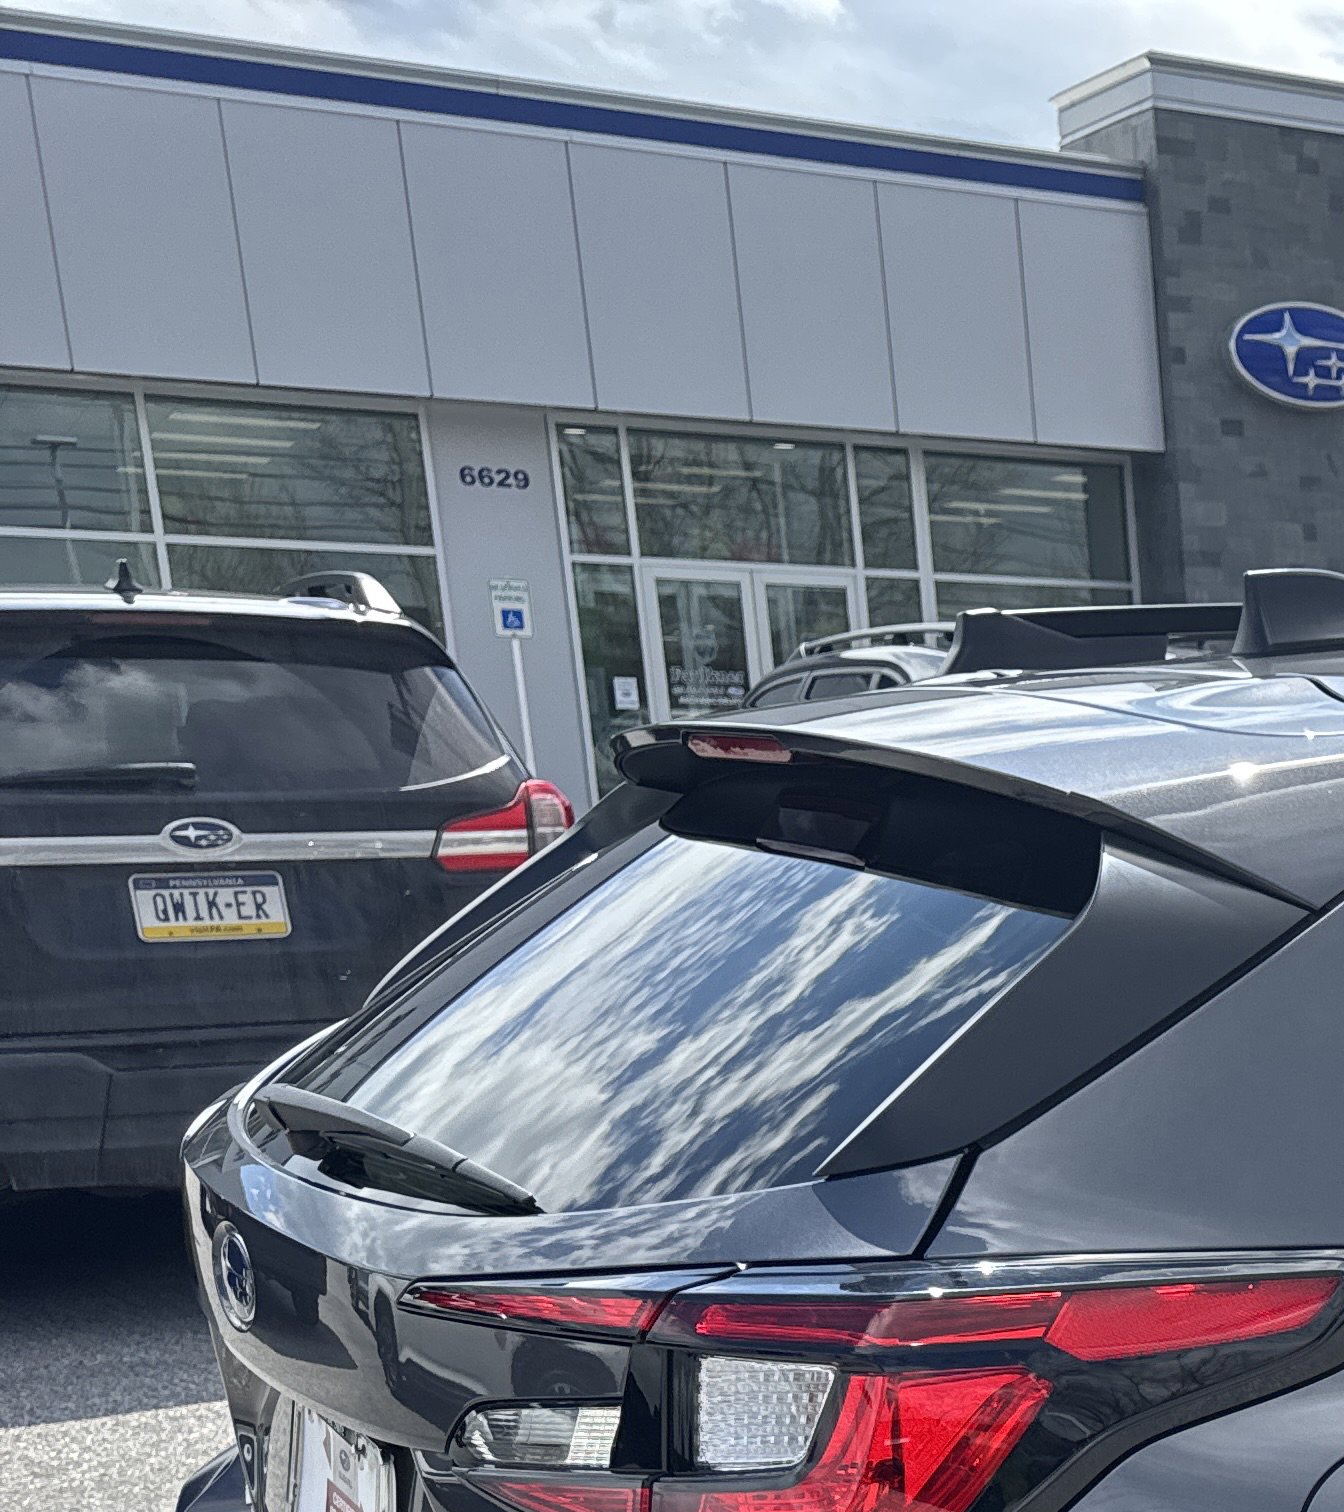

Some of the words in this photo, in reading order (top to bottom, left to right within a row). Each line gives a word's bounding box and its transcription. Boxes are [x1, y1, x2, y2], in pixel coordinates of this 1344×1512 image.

[459, 465, 530, 490] 6629
[169, 877, 244, 888] PENNSYLVANIA
[152, 890, 270, 922] QWIK-ER
